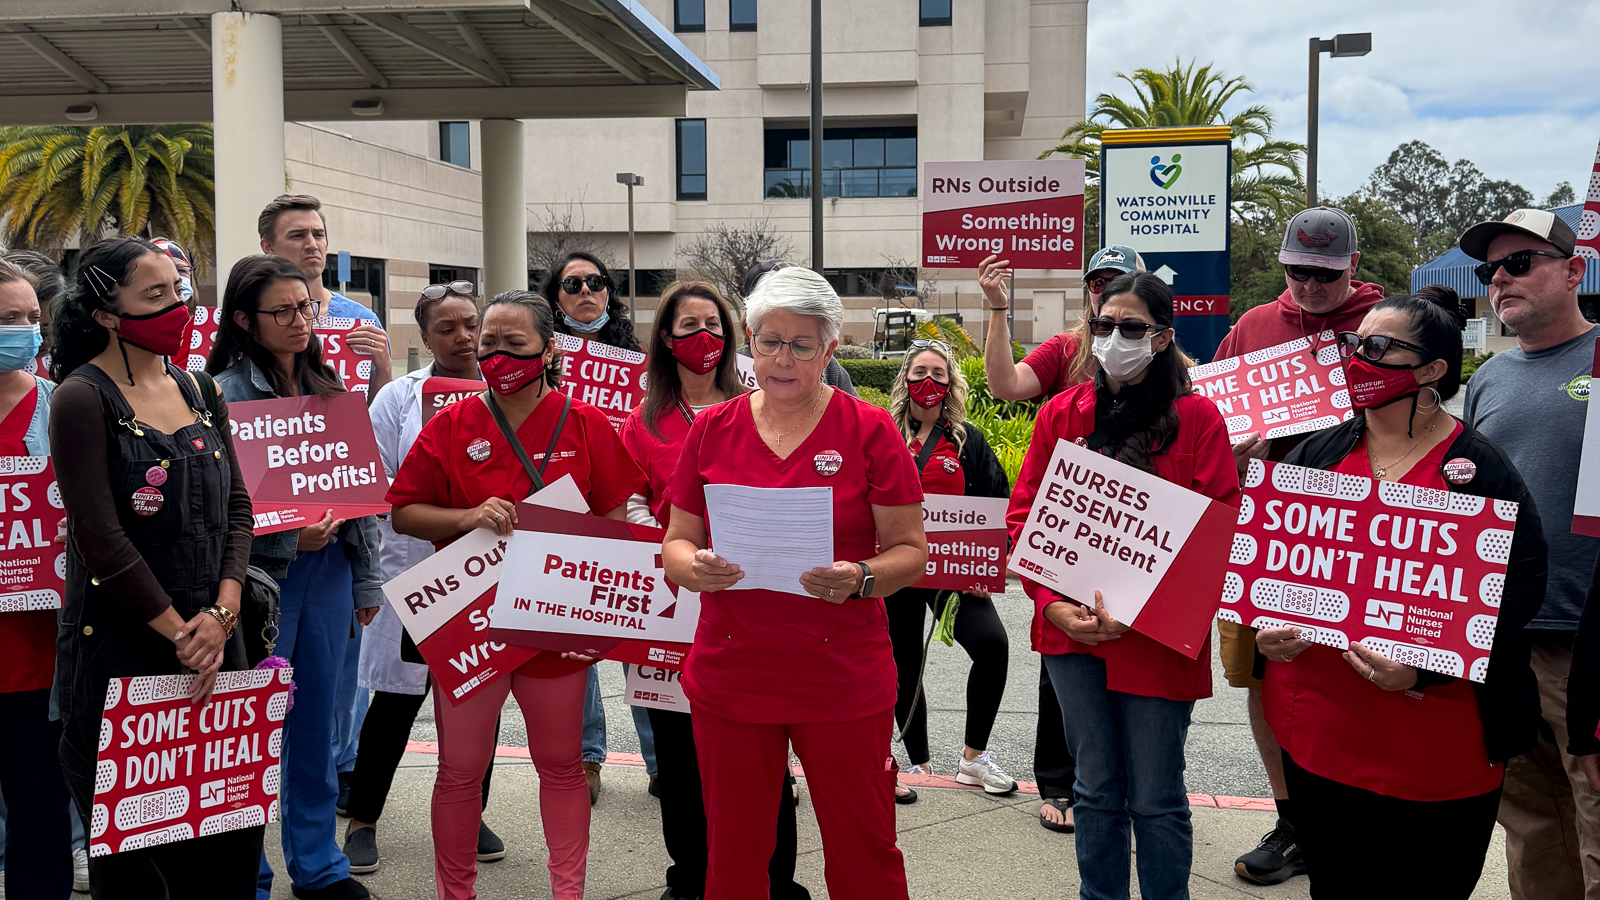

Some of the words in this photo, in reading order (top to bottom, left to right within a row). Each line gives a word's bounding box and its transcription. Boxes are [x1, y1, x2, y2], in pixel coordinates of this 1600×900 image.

[933, 177, 971, 193] RNs
[978, 176, 1060, 193] Outside
[1116, 195, 1216, 207] WATSONVILLE
[962, 213, 1075, 233] Something
[1120, 209, 1210, 221] COMMUNITY
[1131, 224, 1199, 235] HOSPITAL
[935, 234, 1004, 254] Wrong
[1012, 234, 1075, 251] Inside
[316, 334, 341, 354] TS
[580, 360, 631, 387] CUTS
[736, 368, 756, 387] Ns
[1192, 375, 1239, 398] OME
[1247, 355, 1307, 387] CUTS
[432, 391, 482, 408] SAV
[582, 385, 633, 413] HEAL
[1216, 393, 1250, 415] N'T
[1259, 375, 1325, 407] HEAL
[1290, 397, 1321, 409] National
[1291, 405, 1317, 414] Nurses
[1292, 409, 1317, 419] United
[267, 440, 349, 469] Before
[291, 462, 377, 496] Profits!
[1054, 458, 1151, 511] NURSES
[0, 482, 31, 513] TS
[1045, 481, 1173, 553] ESSENTIAL
[0, 518, 51, 551] AL
[1263, 499, 1357, 542] SOME
[1369, 513, 1459, 556] CUTS
[1028, 530, 1079, 566] Care
[1036, 505, 1070, 533] for
[1074, 522, 1157, 573] Patient
[928, 541, 1000, 561] mething
[0, 556, 41, 567] National
[0, 567, 33, 576] Nurses
[943, 559, 999, 577] Inside
[1266, 539, 1364, 585] DON'T
[1373, 556, 1469, 603] HEAL
[0, 574, 33, 585] United
[543, 553, 655, 592] Patients
[404, 575, 460, 616] RNs
[590, 585, 652, 615] First
[513, 597, 531, 611] IN
[535, 601, 567, 617] THE
[570, 607, 647, 631] HOSPITAL
[1407, 614, 1443, 629] Nurses
[1408, 605, 1453, 621] National
[1405, 624, 1441, 638] United
[637, 664, 683, 682] Car
[120, 706, 191, 749] SOME
[199, 696, 257, 734] CUTS
[125, 744, 197, 789] DON'T
[204, 732, 263, 773] HEAL
[227, 771, 255, 785] National
[227, 783, 249, 794] Nurses
[227, 790, 249, 802] United
